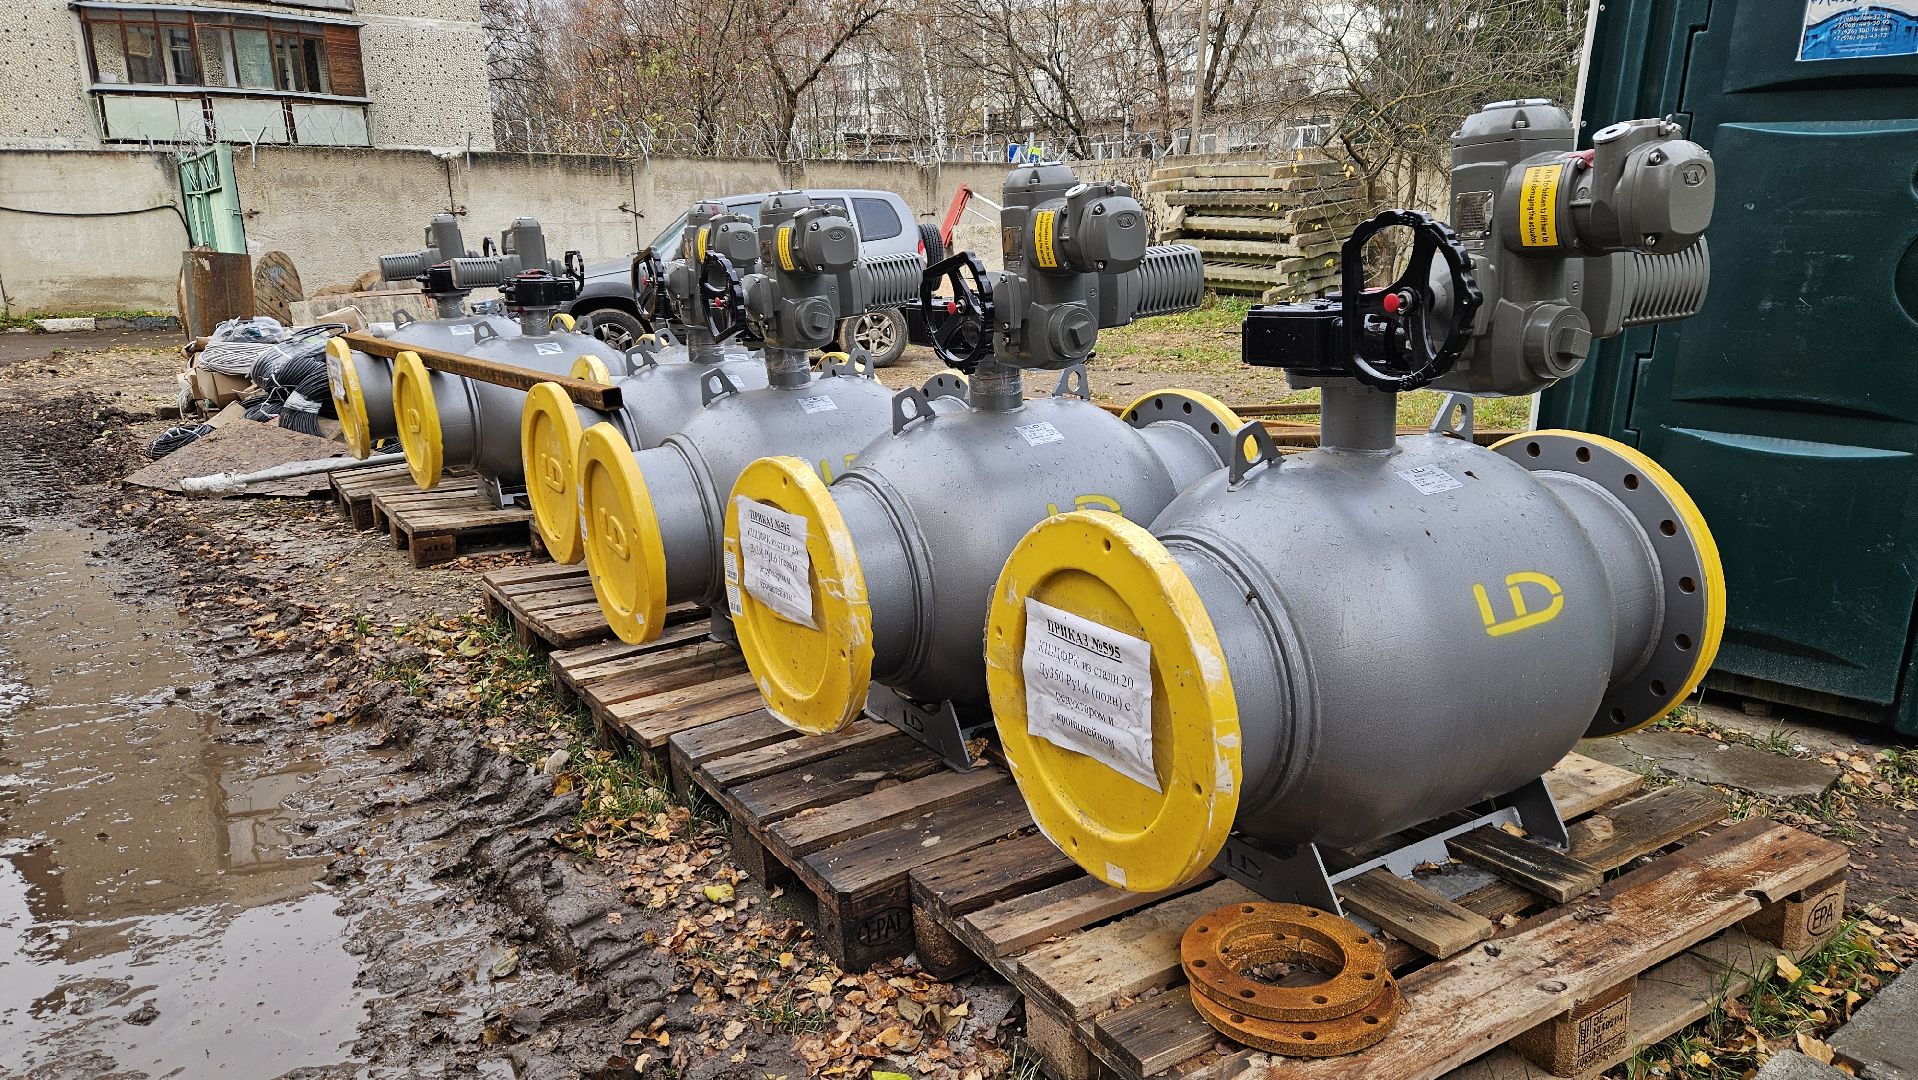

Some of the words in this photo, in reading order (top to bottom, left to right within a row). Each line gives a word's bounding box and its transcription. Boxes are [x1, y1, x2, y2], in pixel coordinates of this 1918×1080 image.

[540, 453, 565, 494] LD
[600, 507, 630, 560] LD
[1472, 570, 1564, 638] LD
[1047, 618, 1089, 646] ПРИКАЗ
[1091, 636, 1121, 658] №595
[1040, 662, 1064, 682] Ду350
[1066, 674, 1089, 694] Ру1,6
[1092, 684, 1122, 710] (полн)
[1125, 702, 1131, 711] с
[1082, 662, 1091, 672] из
[1094, 667, 1119, 685] стали
[1122, 674, 1134, 690] 20
[903, 710, 924, 733] LD
[1056, 712, 1115, 749] кронштейном
[1227, 846, 1263, 881] LD
